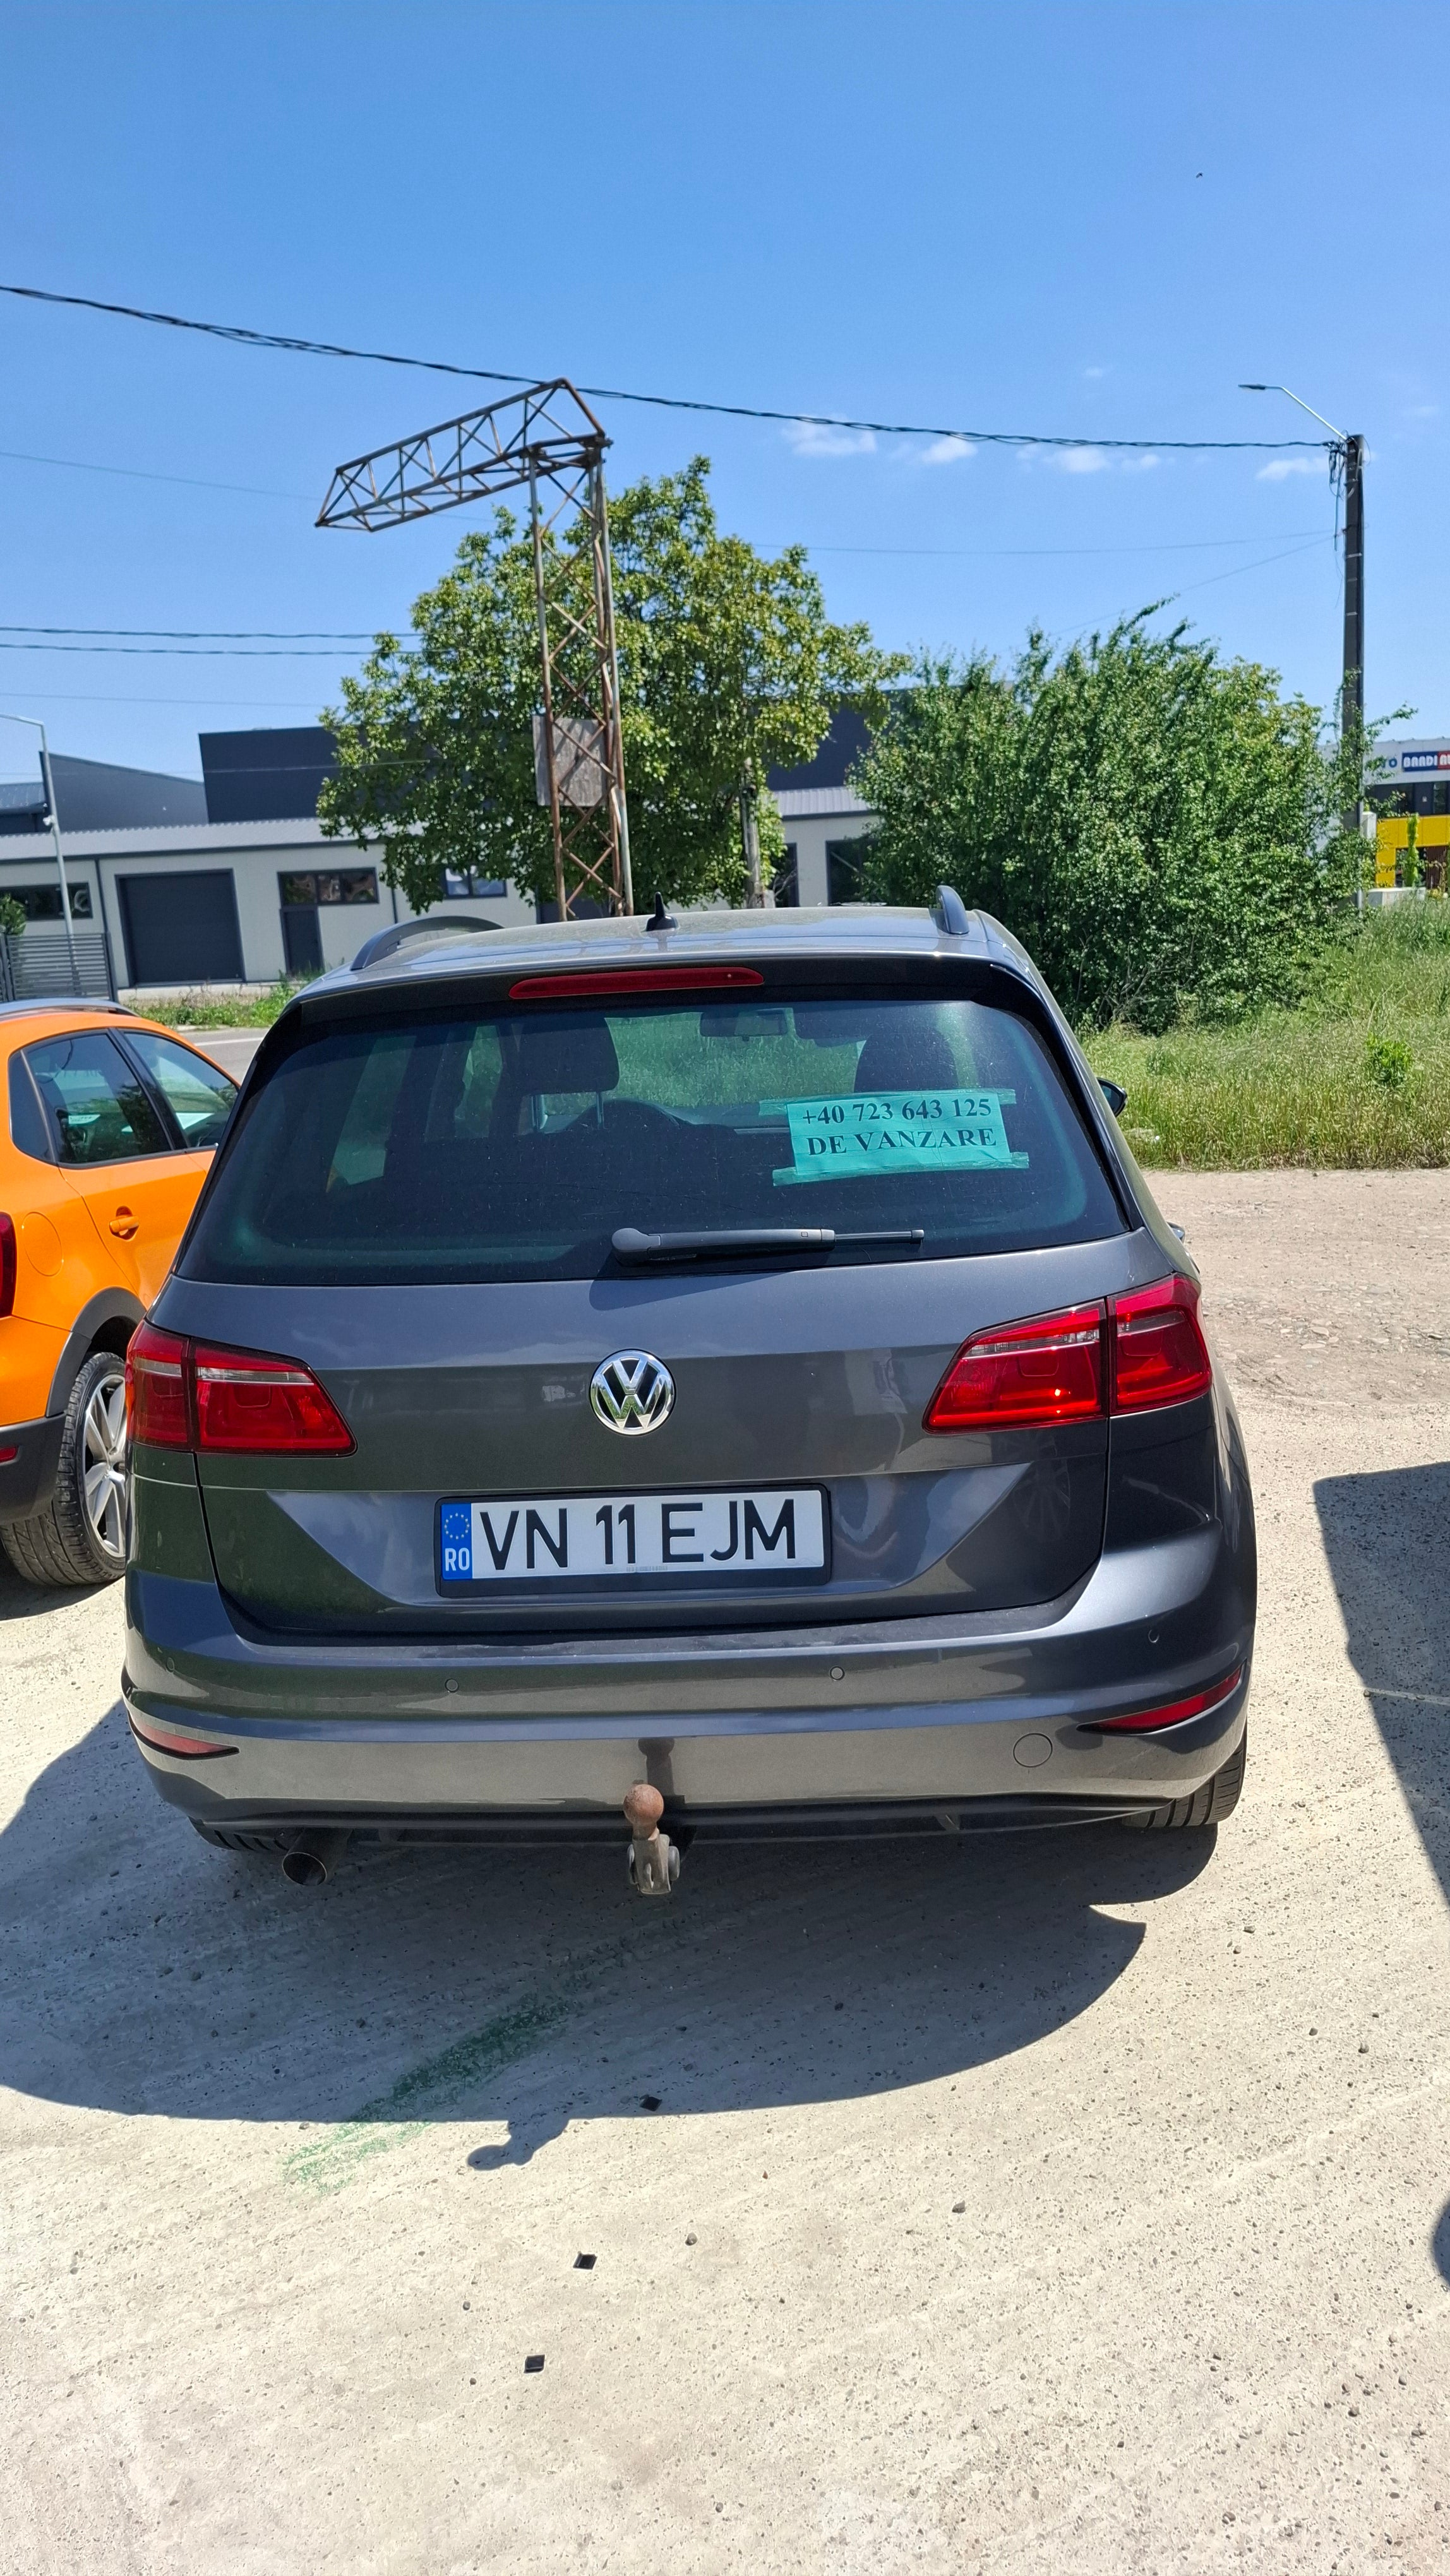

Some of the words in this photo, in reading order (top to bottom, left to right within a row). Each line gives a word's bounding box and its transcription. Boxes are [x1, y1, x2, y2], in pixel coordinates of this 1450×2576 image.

[802, 1105, 845, 1124] +40
[852, 1103, 893, 1121] 723
[902, 1099, 942, 1120] 643
[952, 1099, 992, 1117] 125
[806, 1135, 847, 1155] DE
[854, 1128, 997, 1152] VANZARE
[594, 1352, 671, 1432] VW
[479, 1508, 568, 1570] VN
[596, 1504, 636, 1565] 11
[661, 1498, 796, 1563] EJM
[445, 1547, 470, 1571] RO
